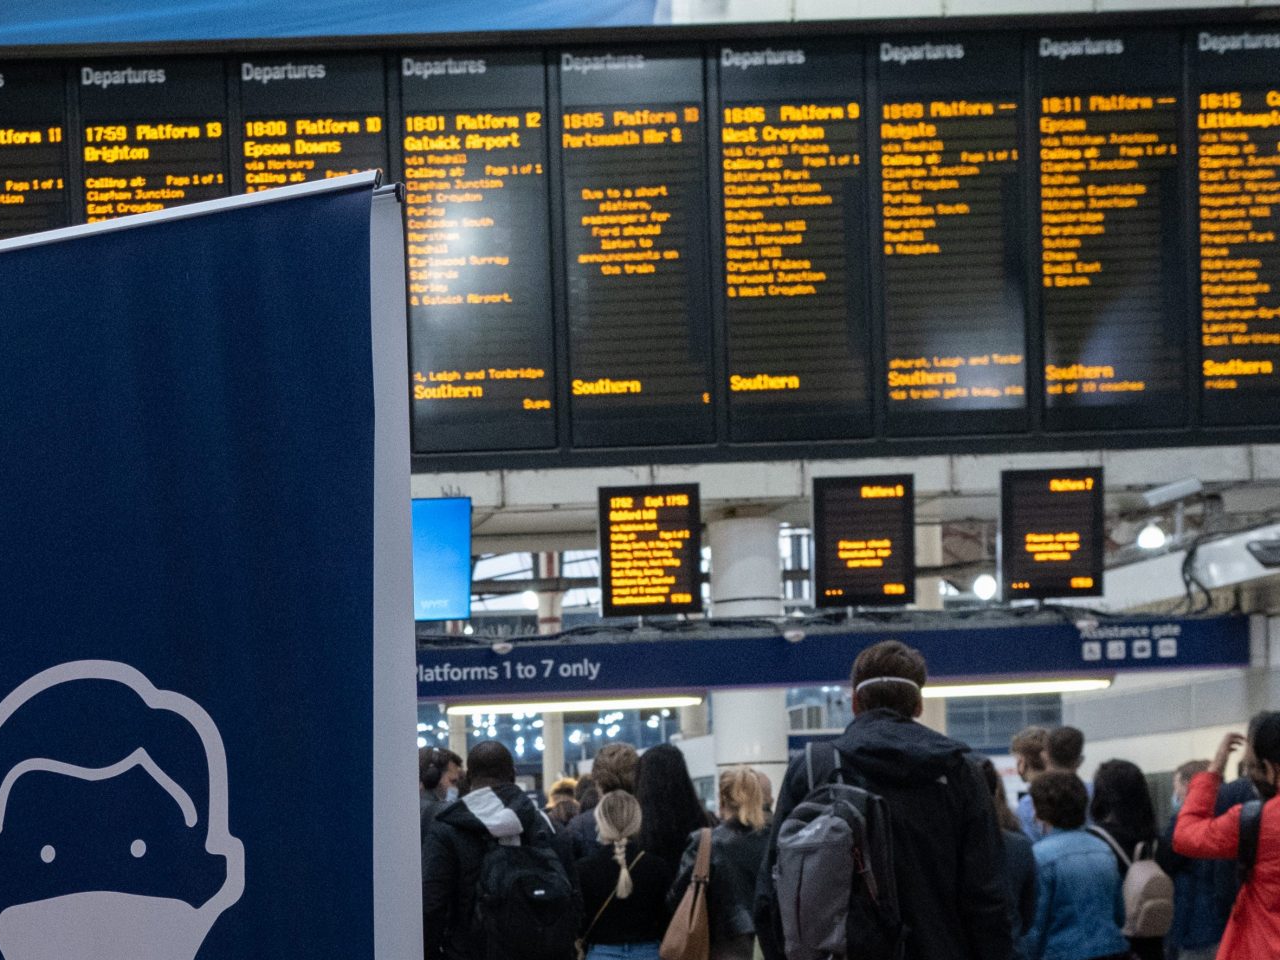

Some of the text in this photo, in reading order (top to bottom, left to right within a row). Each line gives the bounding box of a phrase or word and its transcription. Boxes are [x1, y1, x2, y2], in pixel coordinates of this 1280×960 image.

[880, 44, 964, 64] Departures
[1040, 39, 1123, 59] Departures
[561, 54, 646, 75] Departures
[721, 49, 805, 69] Departures
[242, 63, 326, 84] Departures
[403, 59, 486, 79] Departures
[82, 68, 165, 88] Departures
[405, 116, 446, 131] 18:01
[455, 115, 520, 130] Platform
[612, 112, 677, 125] Platform
[47, 128, 62, 142] 11
[85, 126, 128, 141] 17:59
[135, 125, 201, 139] Platform
[245, 121, 287, 136] 18:00
[295, 120, 360, 134] Platform
[243, 139, 342, 157] Epsom Downs
[403, 134, 520, 151] Gatwick Airport
[84, 146, 150, 162] Brighton
[1045, 366, 1113, 379] Southern
[1203, 360, 1273, 375] Southern
[572, 380, 642, 394] Southern
[729, 375, 800, 390] Southern
[888, 372, 956, 386] Southern
[414, 384, 483, 399] Southern
[503, 661, 511, 678] 1
[516, 663, 536, 678] to
[541, 660, 554, 677] 7
[559, 659, 600, 680] only
